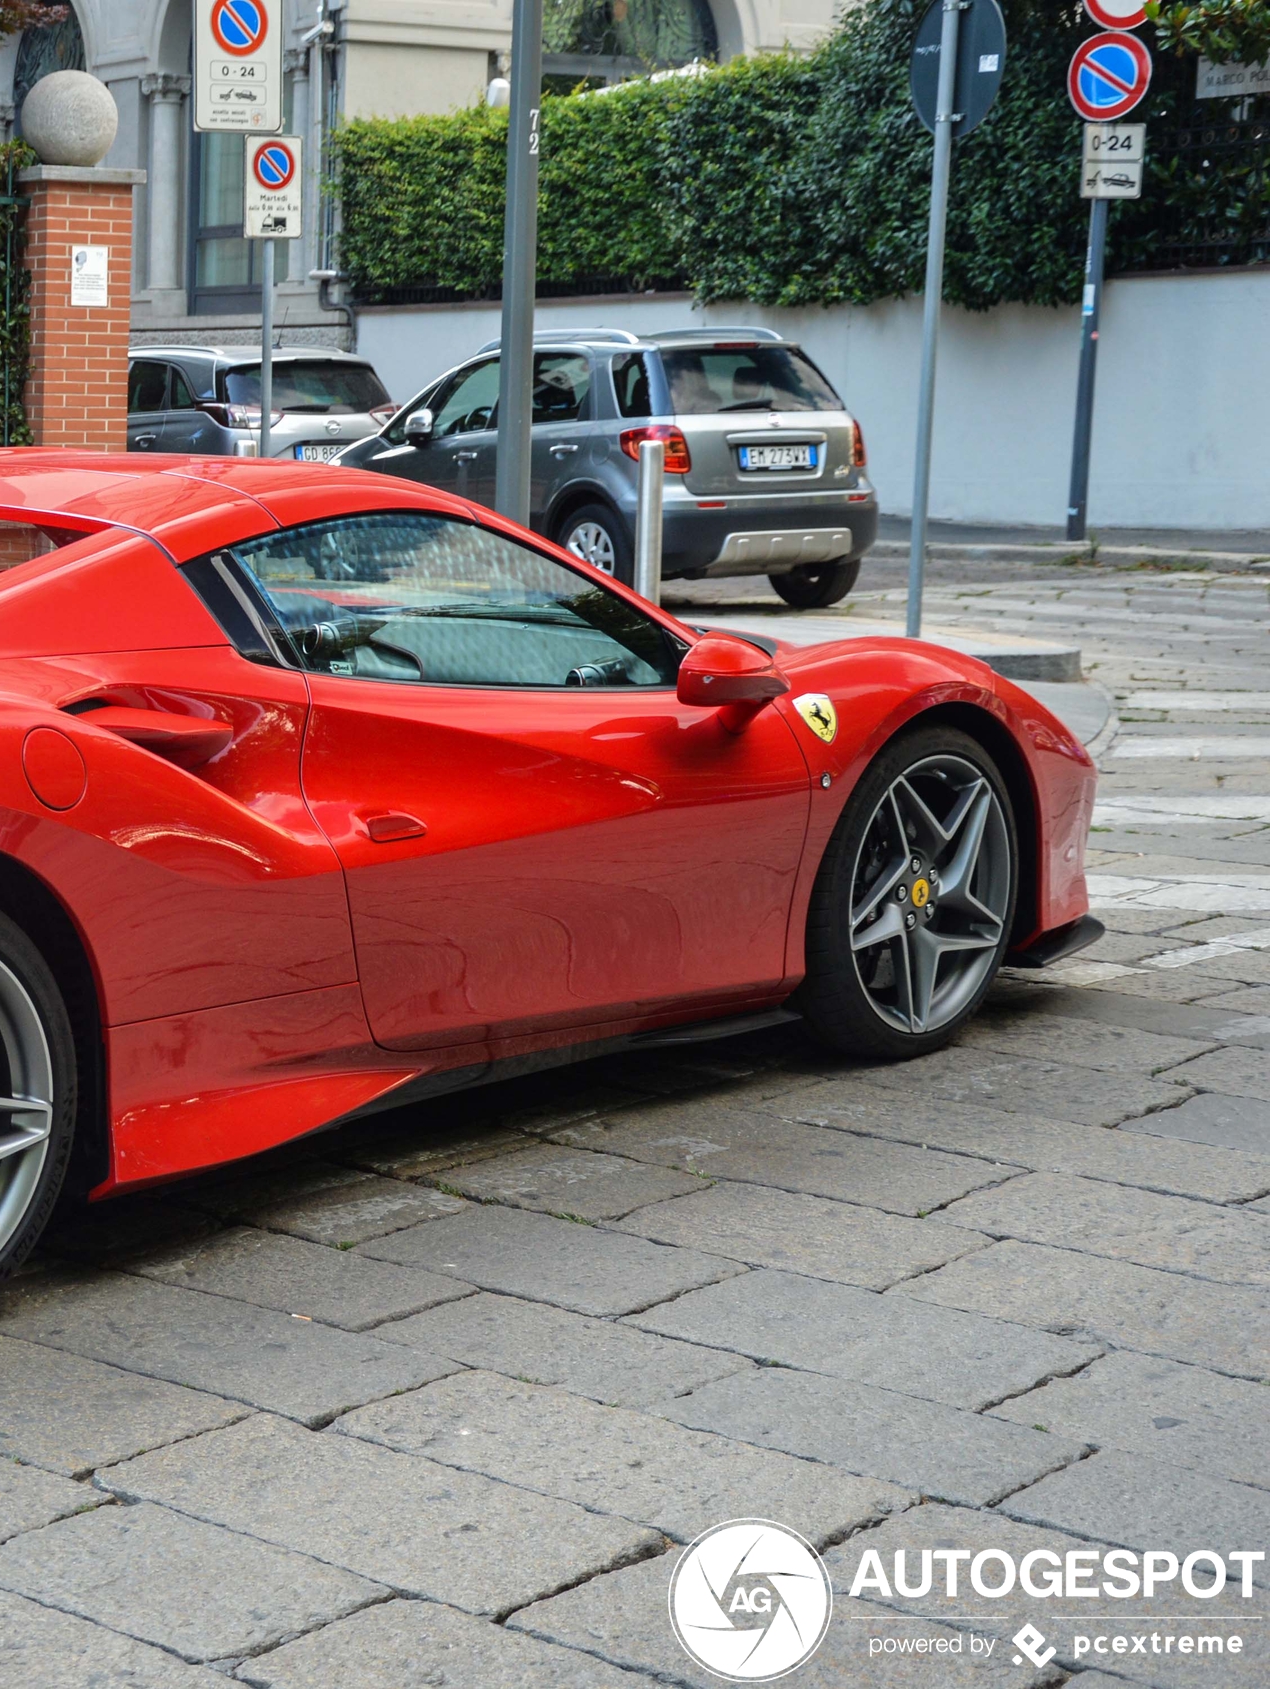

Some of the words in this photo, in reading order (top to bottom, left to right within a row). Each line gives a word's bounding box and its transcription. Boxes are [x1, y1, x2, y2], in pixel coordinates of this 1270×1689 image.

[1092, 135, 1133, 151] 0-24
[304, 448, 318, 460] GD
[750, 449, 765, 464] EM
